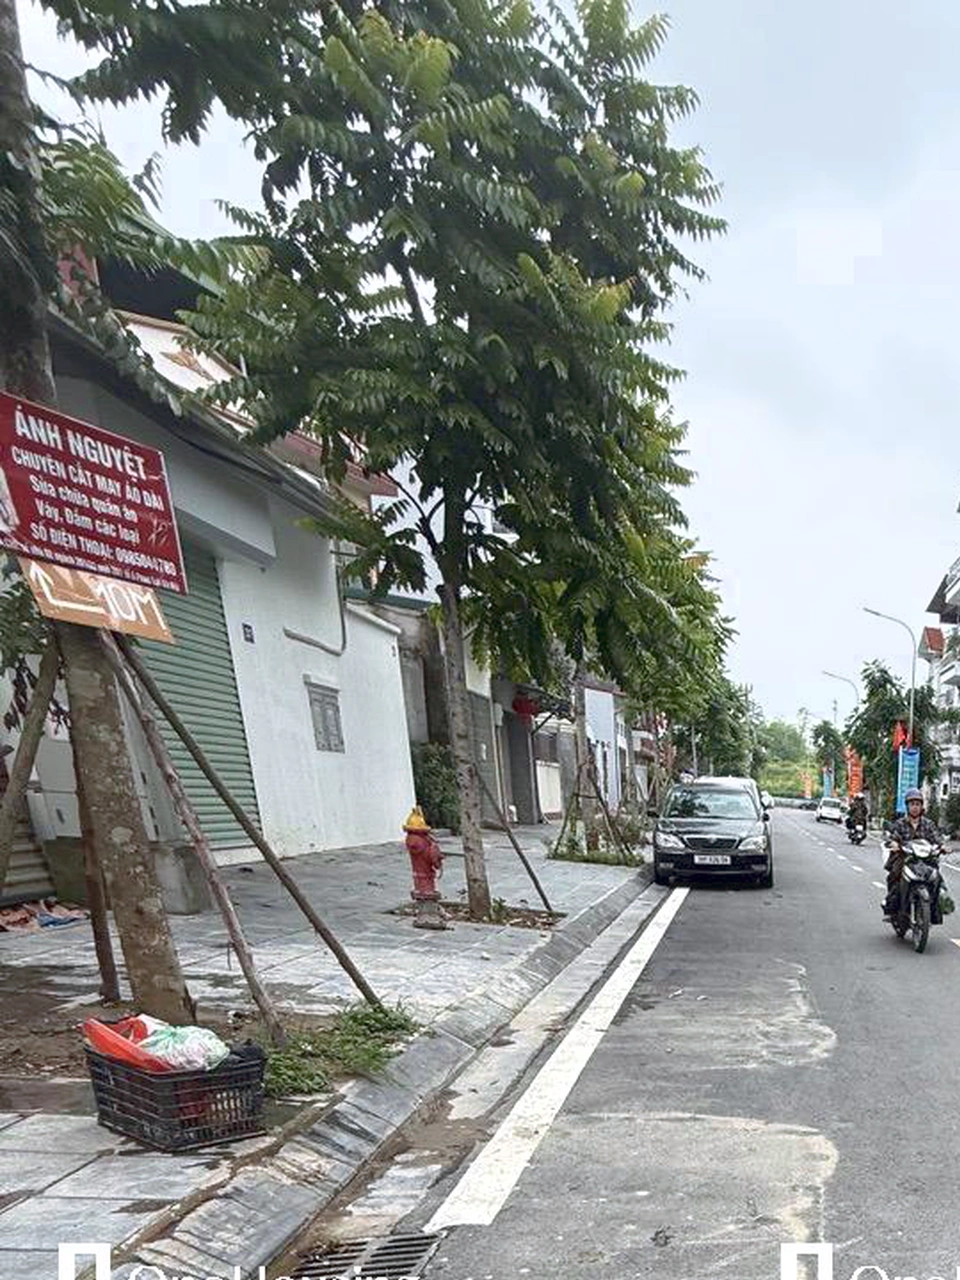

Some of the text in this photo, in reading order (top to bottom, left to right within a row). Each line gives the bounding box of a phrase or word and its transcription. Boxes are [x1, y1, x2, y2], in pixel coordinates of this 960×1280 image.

[11, 446, 66, 480] CHUYÊN
[68, 460, 93, 488] CẮT
[94, 474, 121, 498] MAY
[67, 429, 146, 482] NGUYỆT
